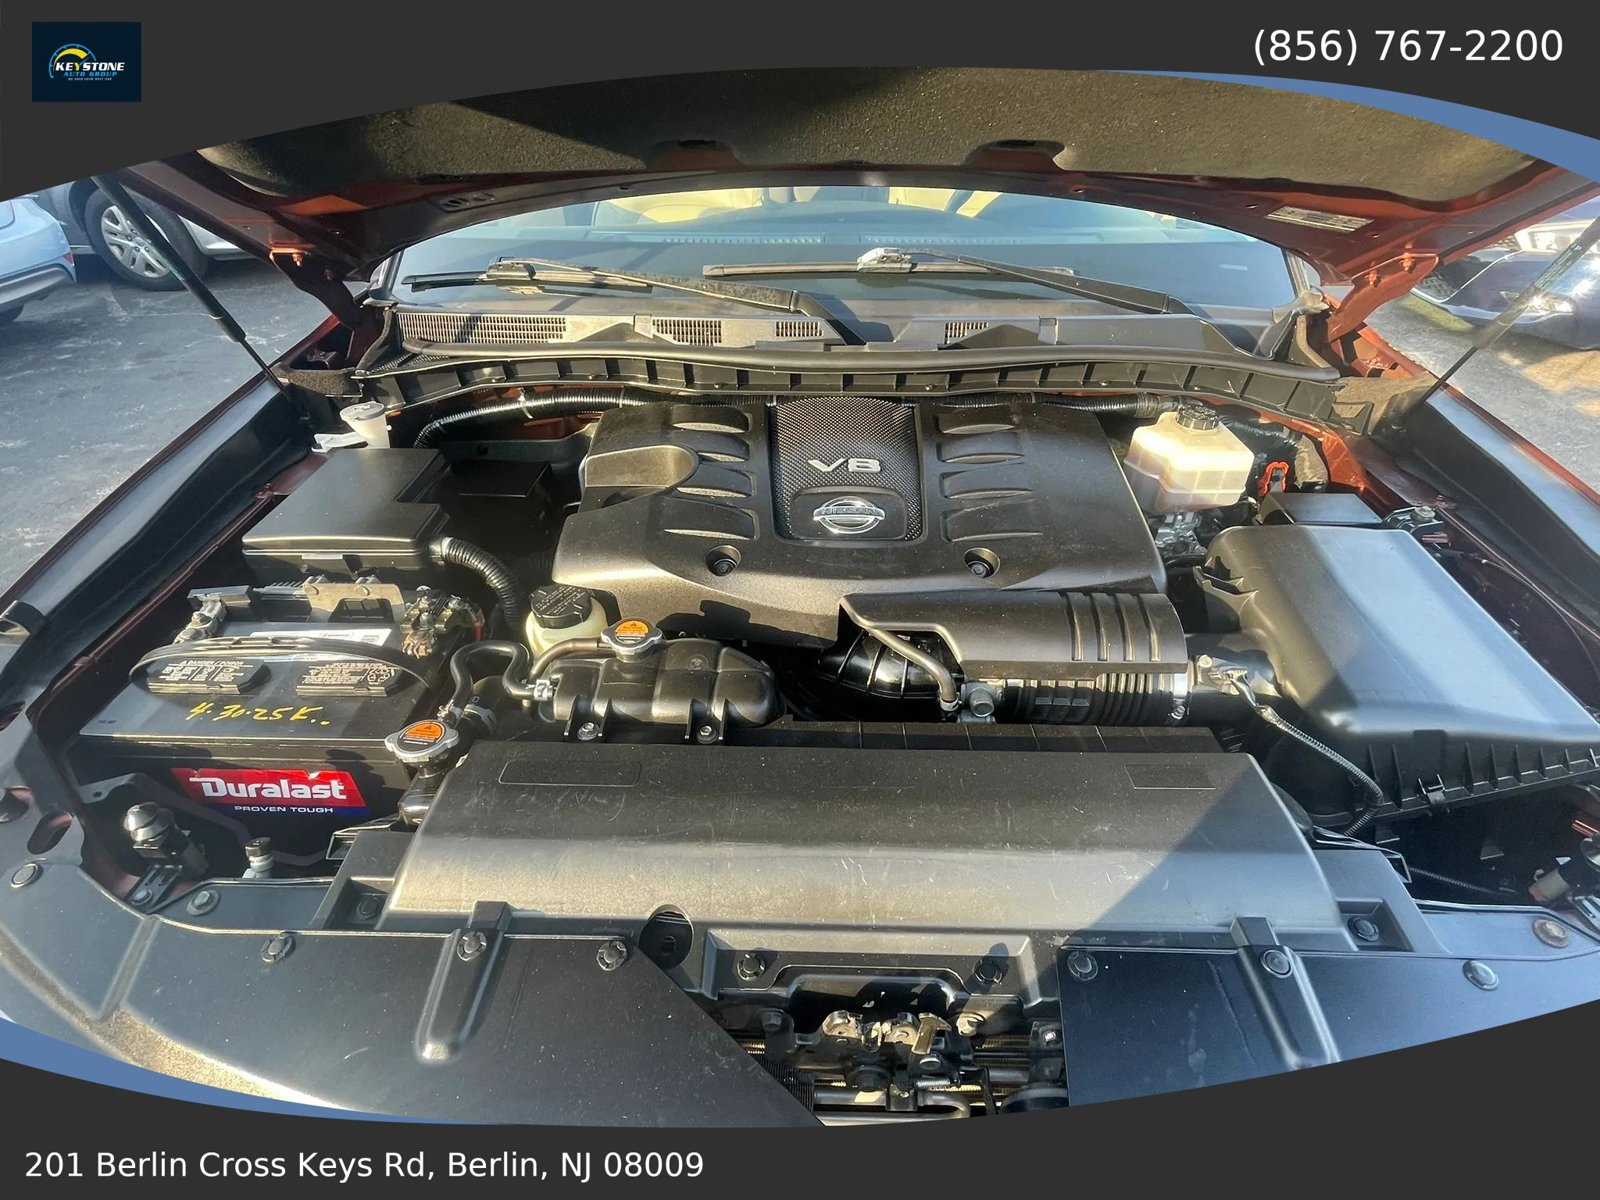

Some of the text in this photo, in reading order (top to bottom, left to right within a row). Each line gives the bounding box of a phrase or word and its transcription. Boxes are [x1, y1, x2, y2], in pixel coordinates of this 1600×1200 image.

[808, 458, 881, 473] V8
[189, 777, 347, 800] Duralast
[290, 806, 334, 814] TOUGH
